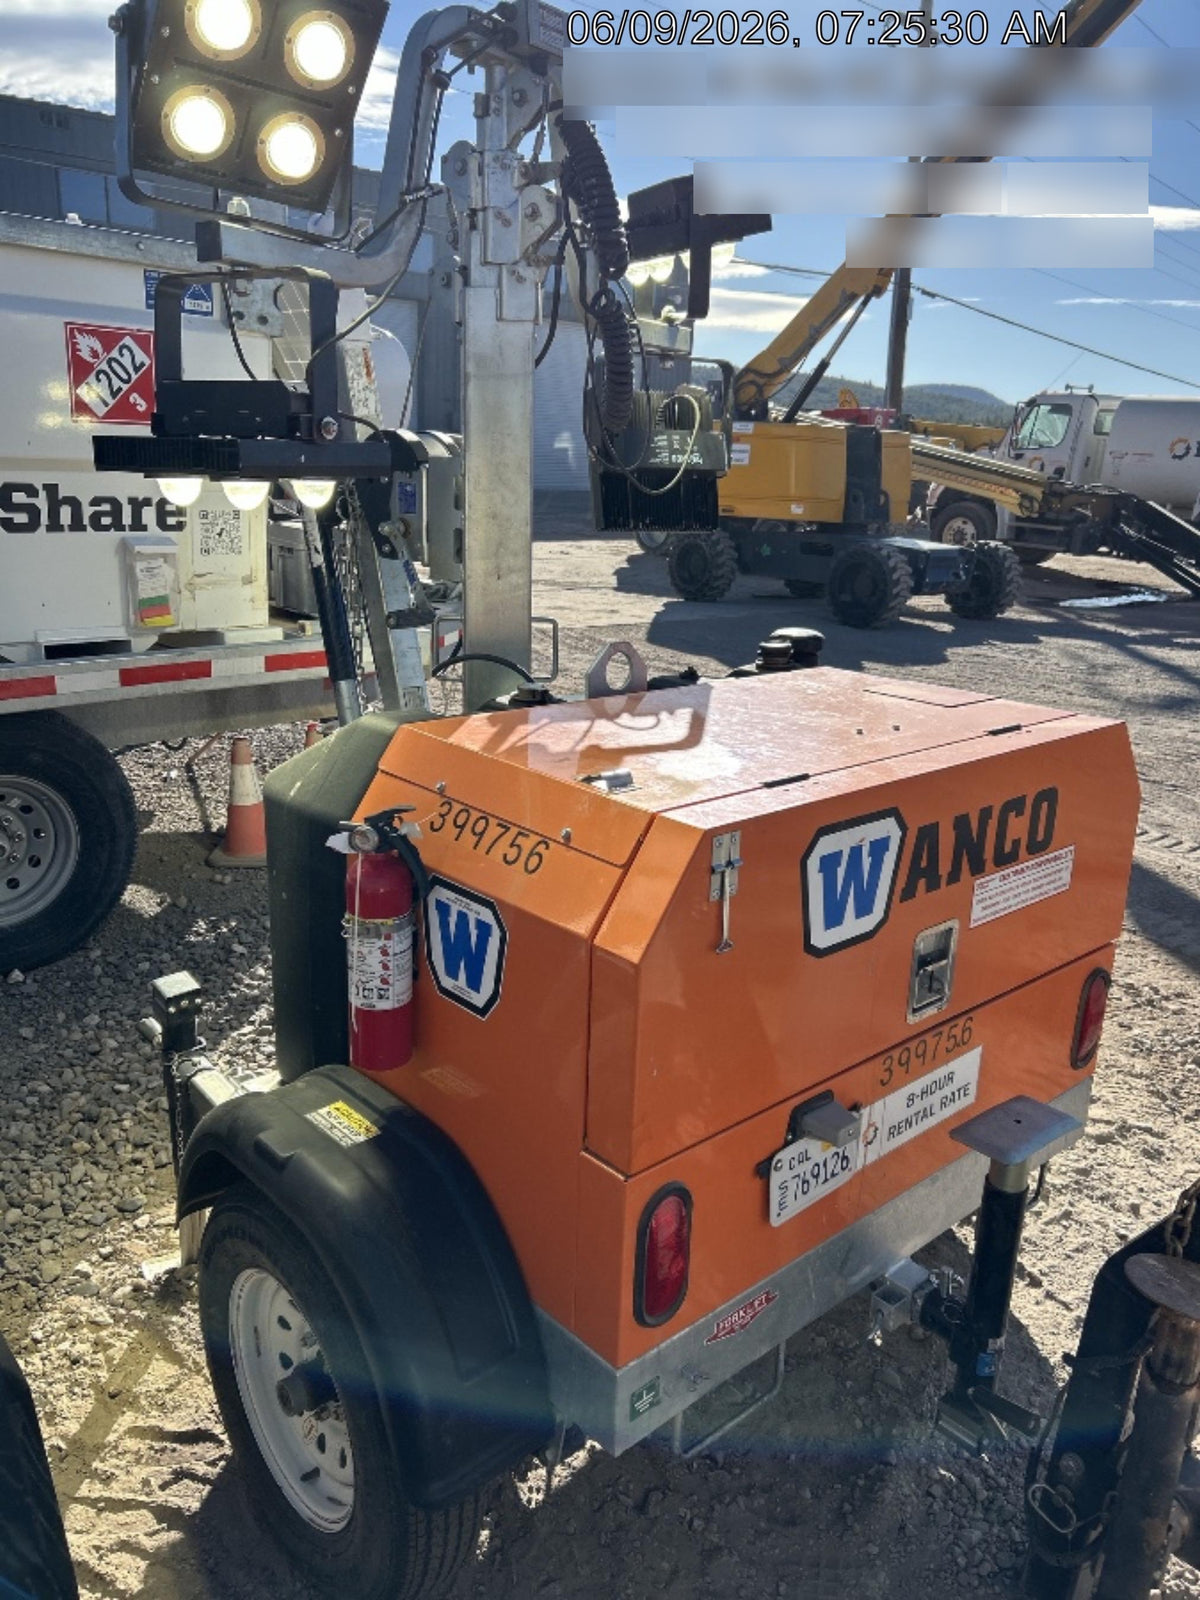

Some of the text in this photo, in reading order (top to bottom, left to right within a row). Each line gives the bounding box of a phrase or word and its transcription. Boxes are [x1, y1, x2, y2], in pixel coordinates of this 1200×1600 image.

[87, 343, 146, 408] 1202
[129, 392, 148, 412] 3
[0, 481, 187, 534] Share
[429, 800, 550, 875] 399756
[880, 1016, 974, 1088] 399756
[887, 1081, 972, 1141] RENTAL RATE
[906, 1071, 956, 1108] 8-HOUR
[788, 1148, 812, 1171] CAL
[791, 1146, 850, 1201] 769126
